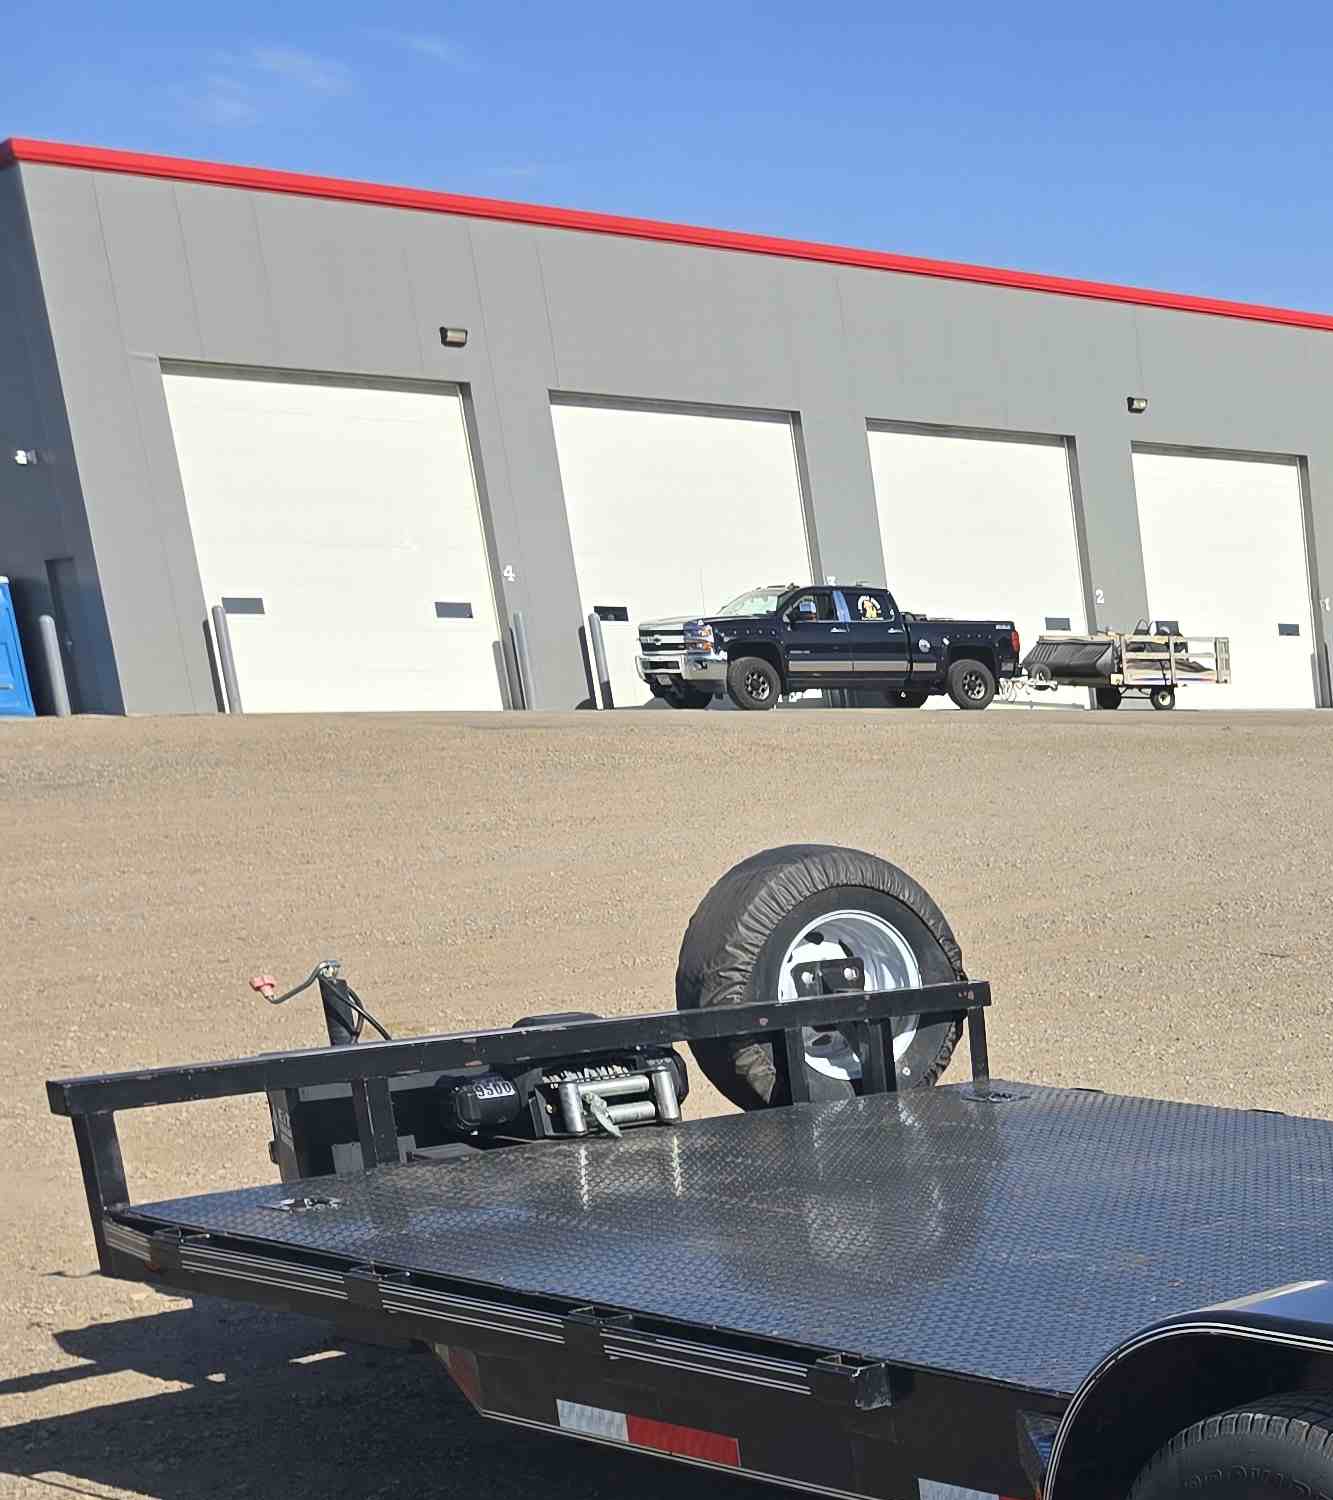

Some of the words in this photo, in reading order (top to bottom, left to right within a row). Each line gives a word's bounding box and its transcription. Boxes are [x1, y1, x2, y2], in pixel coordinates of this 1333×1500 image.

[503, 564, 515, 581] 4
[1095, 589, 1105, 604] 2
[475, 1082, 511, 1096] 9500
